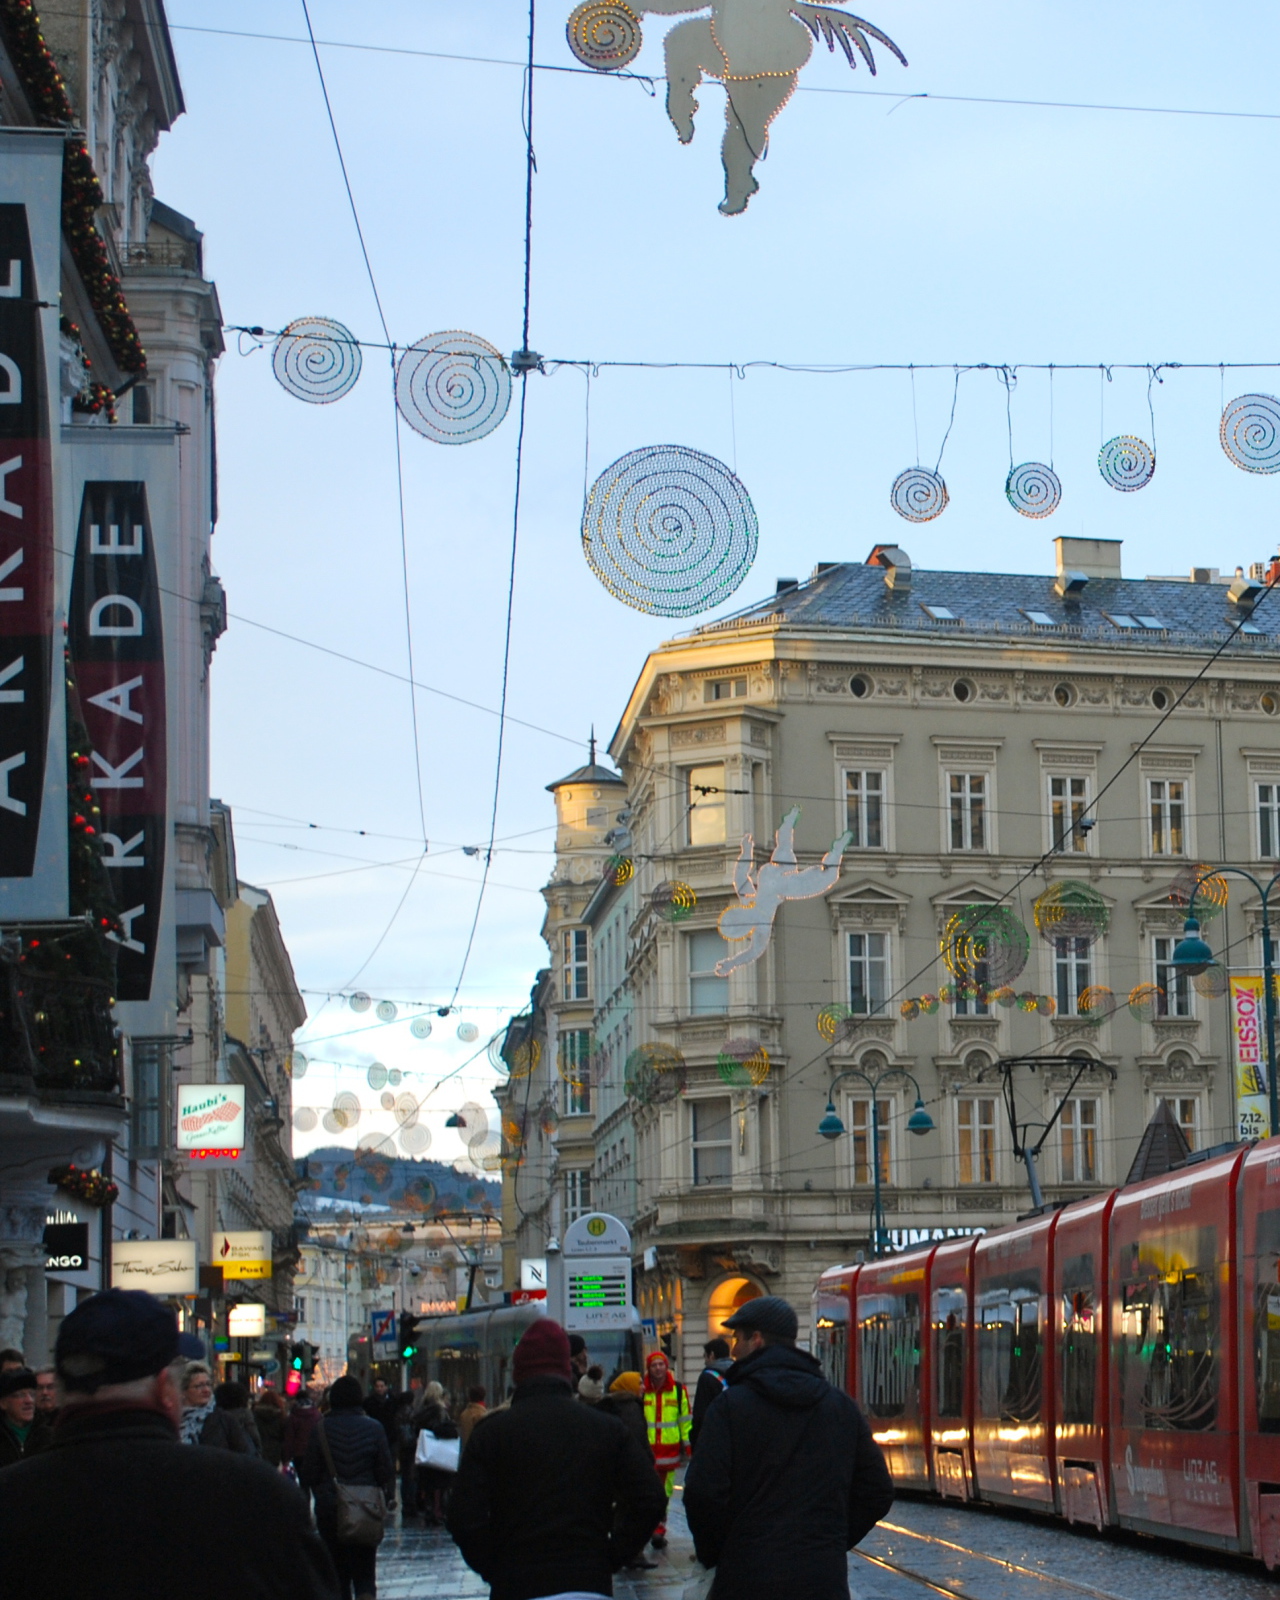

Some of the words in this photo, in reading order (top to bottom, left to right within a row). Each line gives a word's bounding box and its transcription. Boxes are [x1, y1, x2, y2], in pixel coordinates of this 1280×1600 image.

[183, 1093, 227, 1116] Haubi's
[1240, 1125, 1259, 1135] bis
[46, 1255, 82, 1268] NGO
[240, 1266, 264, 1274] Post
